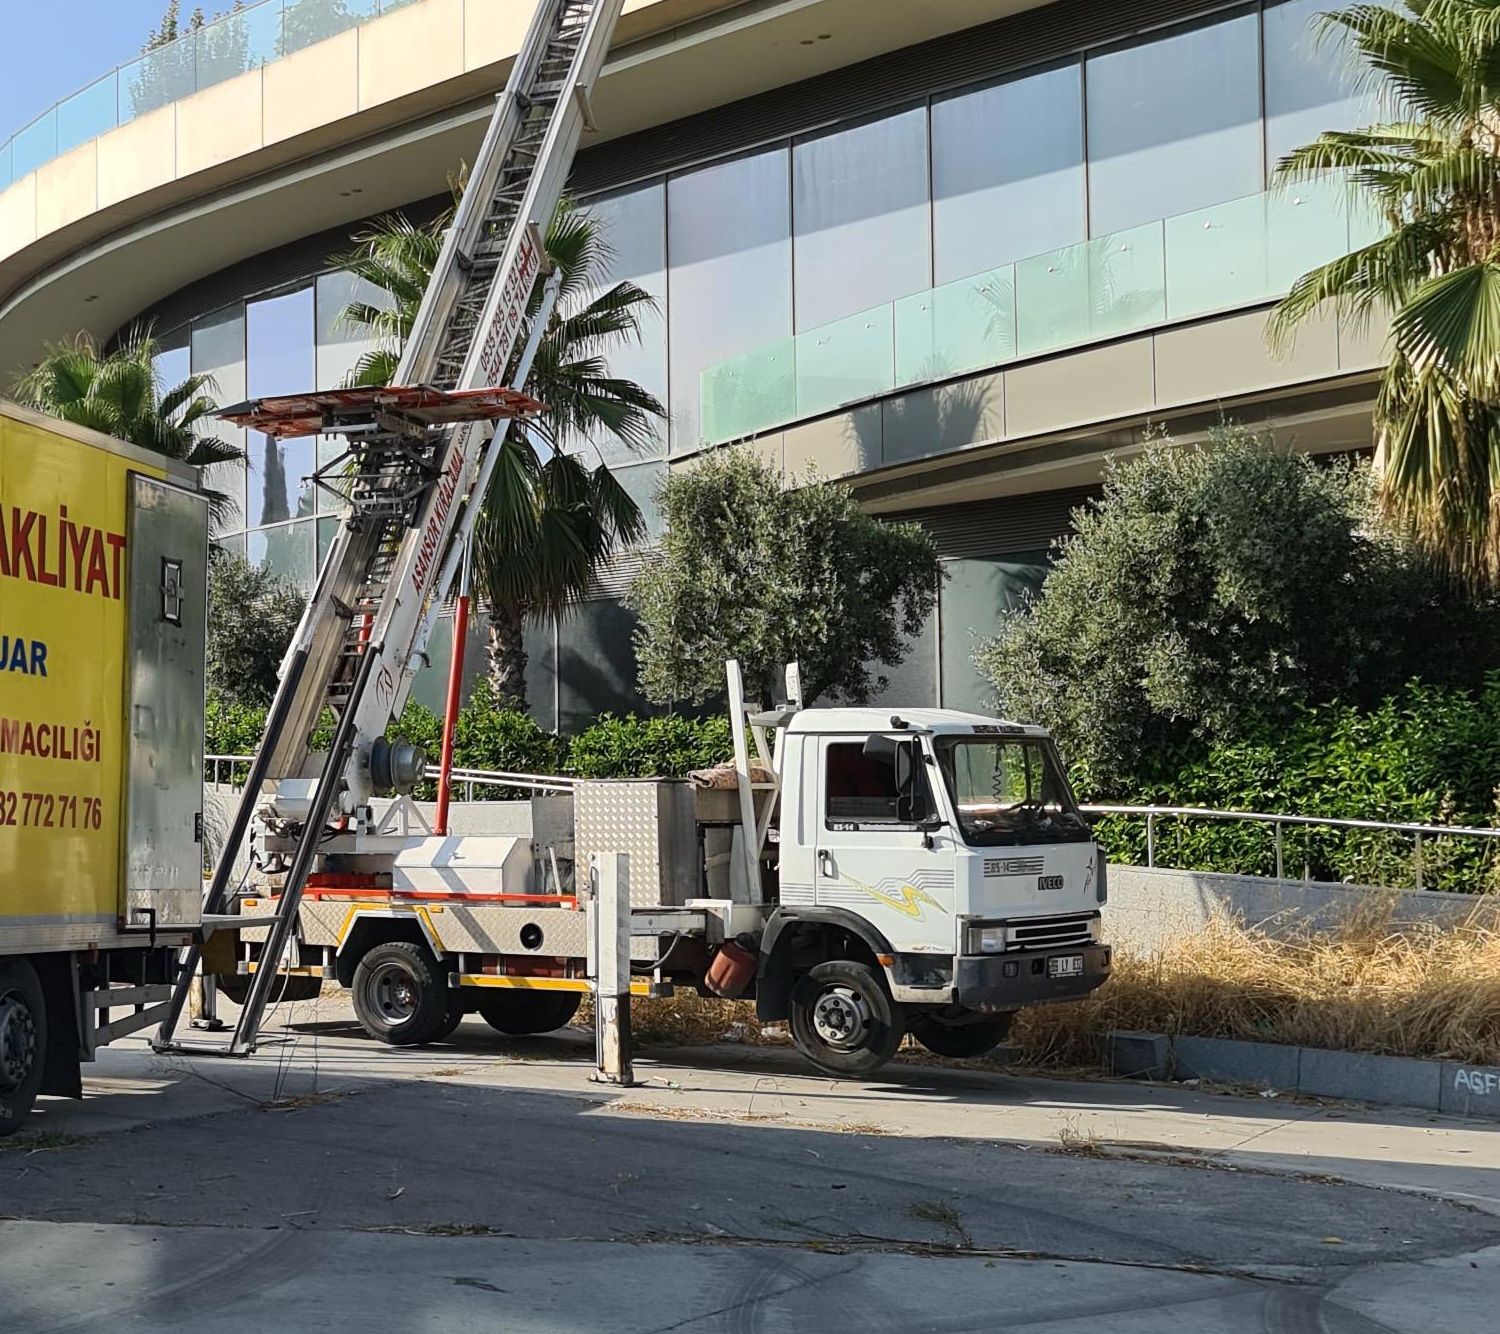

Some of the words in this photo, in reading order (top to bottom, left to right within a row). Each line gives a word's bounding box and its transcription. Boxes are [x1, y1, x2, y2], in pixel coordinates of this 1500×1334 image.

[411, 516, 441, 597] ASANSOR
[22, 792, 55, 828] 772
[58, 795, 77, 829] 71
[83, 797, 102, 831] 76
[1038, 875, 1063, 890] IVECO
[1455, 1069, 1500, 1094] AGF
